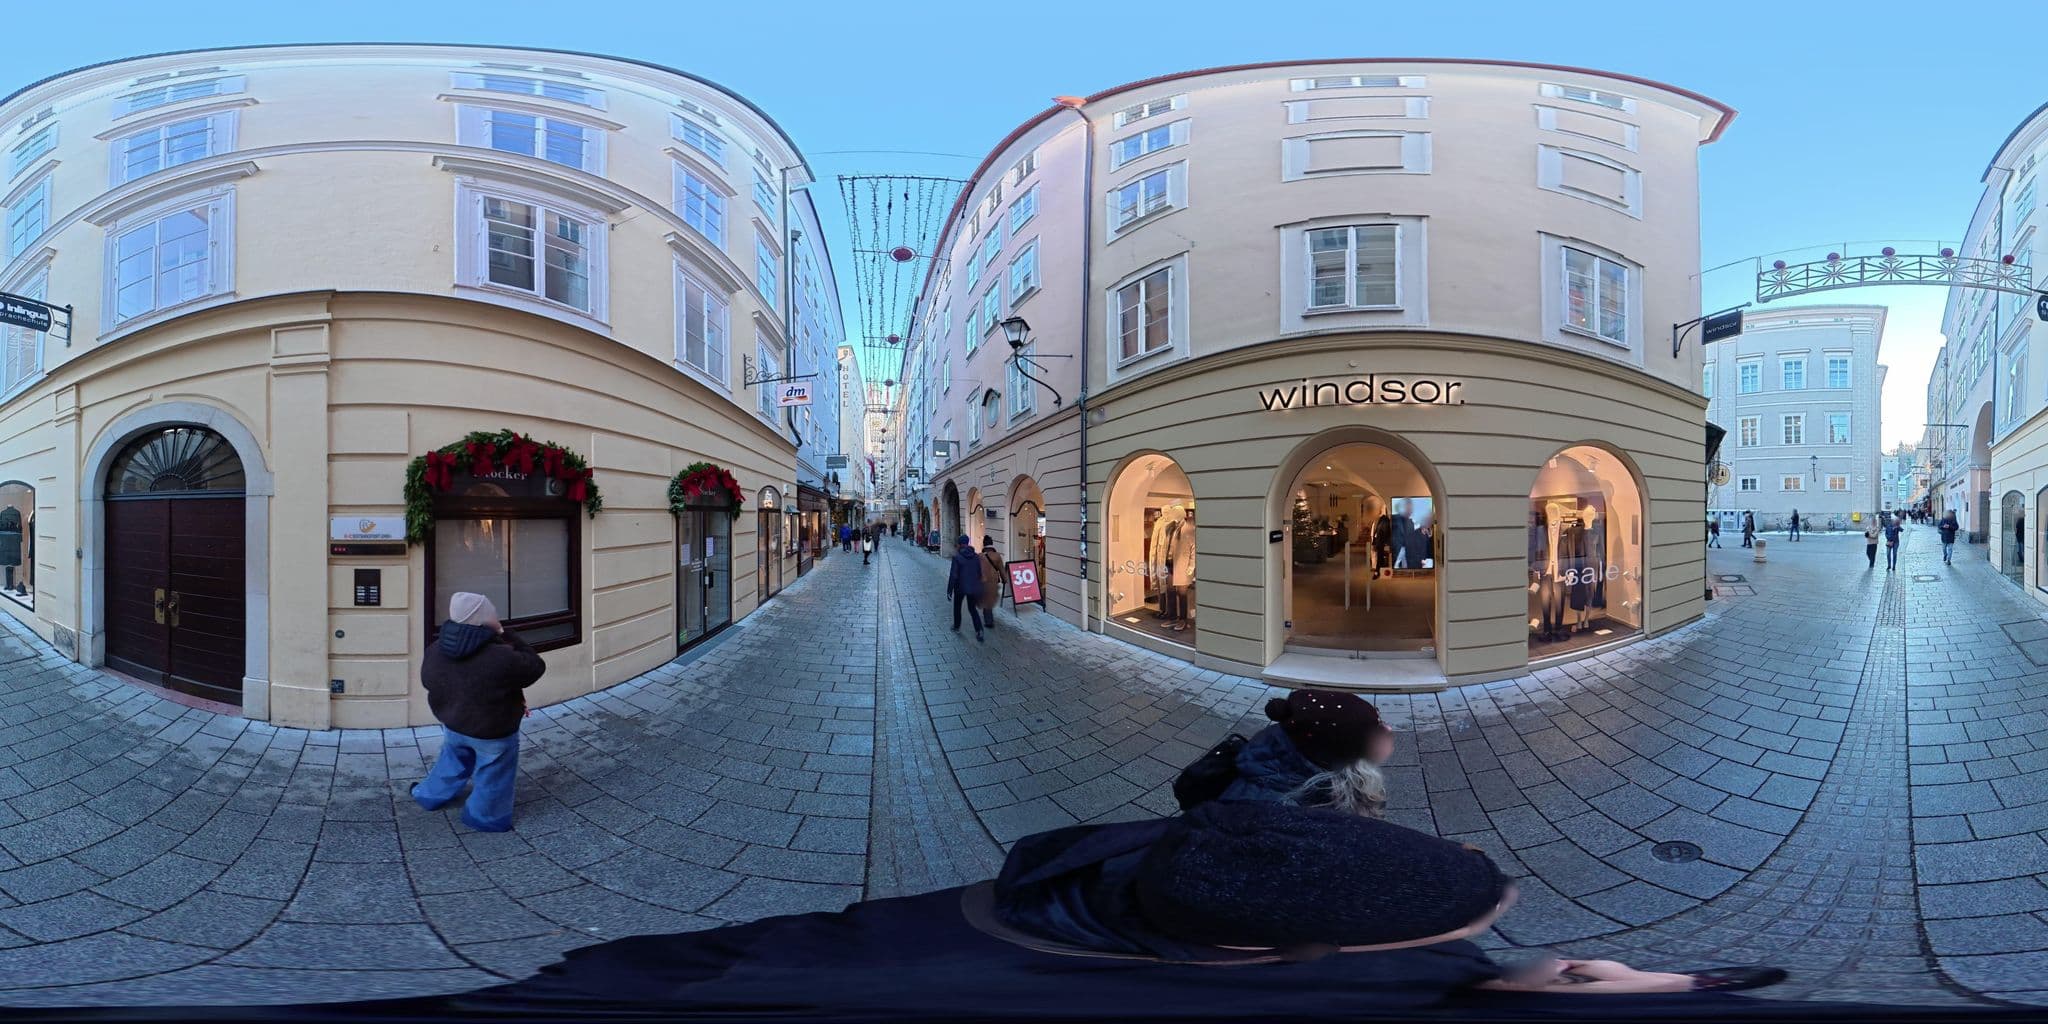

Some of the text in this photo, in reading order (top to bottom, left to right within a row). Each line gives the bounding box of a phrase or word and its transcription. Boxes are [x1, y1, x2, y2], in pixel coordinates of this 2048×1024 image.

[786, 386, 806, 397] dm
[1259, 374, 1465, 410] windsor.
[473, 464, 528, 480] ocker
[1013, 569, 1034, 585] 30
[1564, 561, 1620, 586] sale
